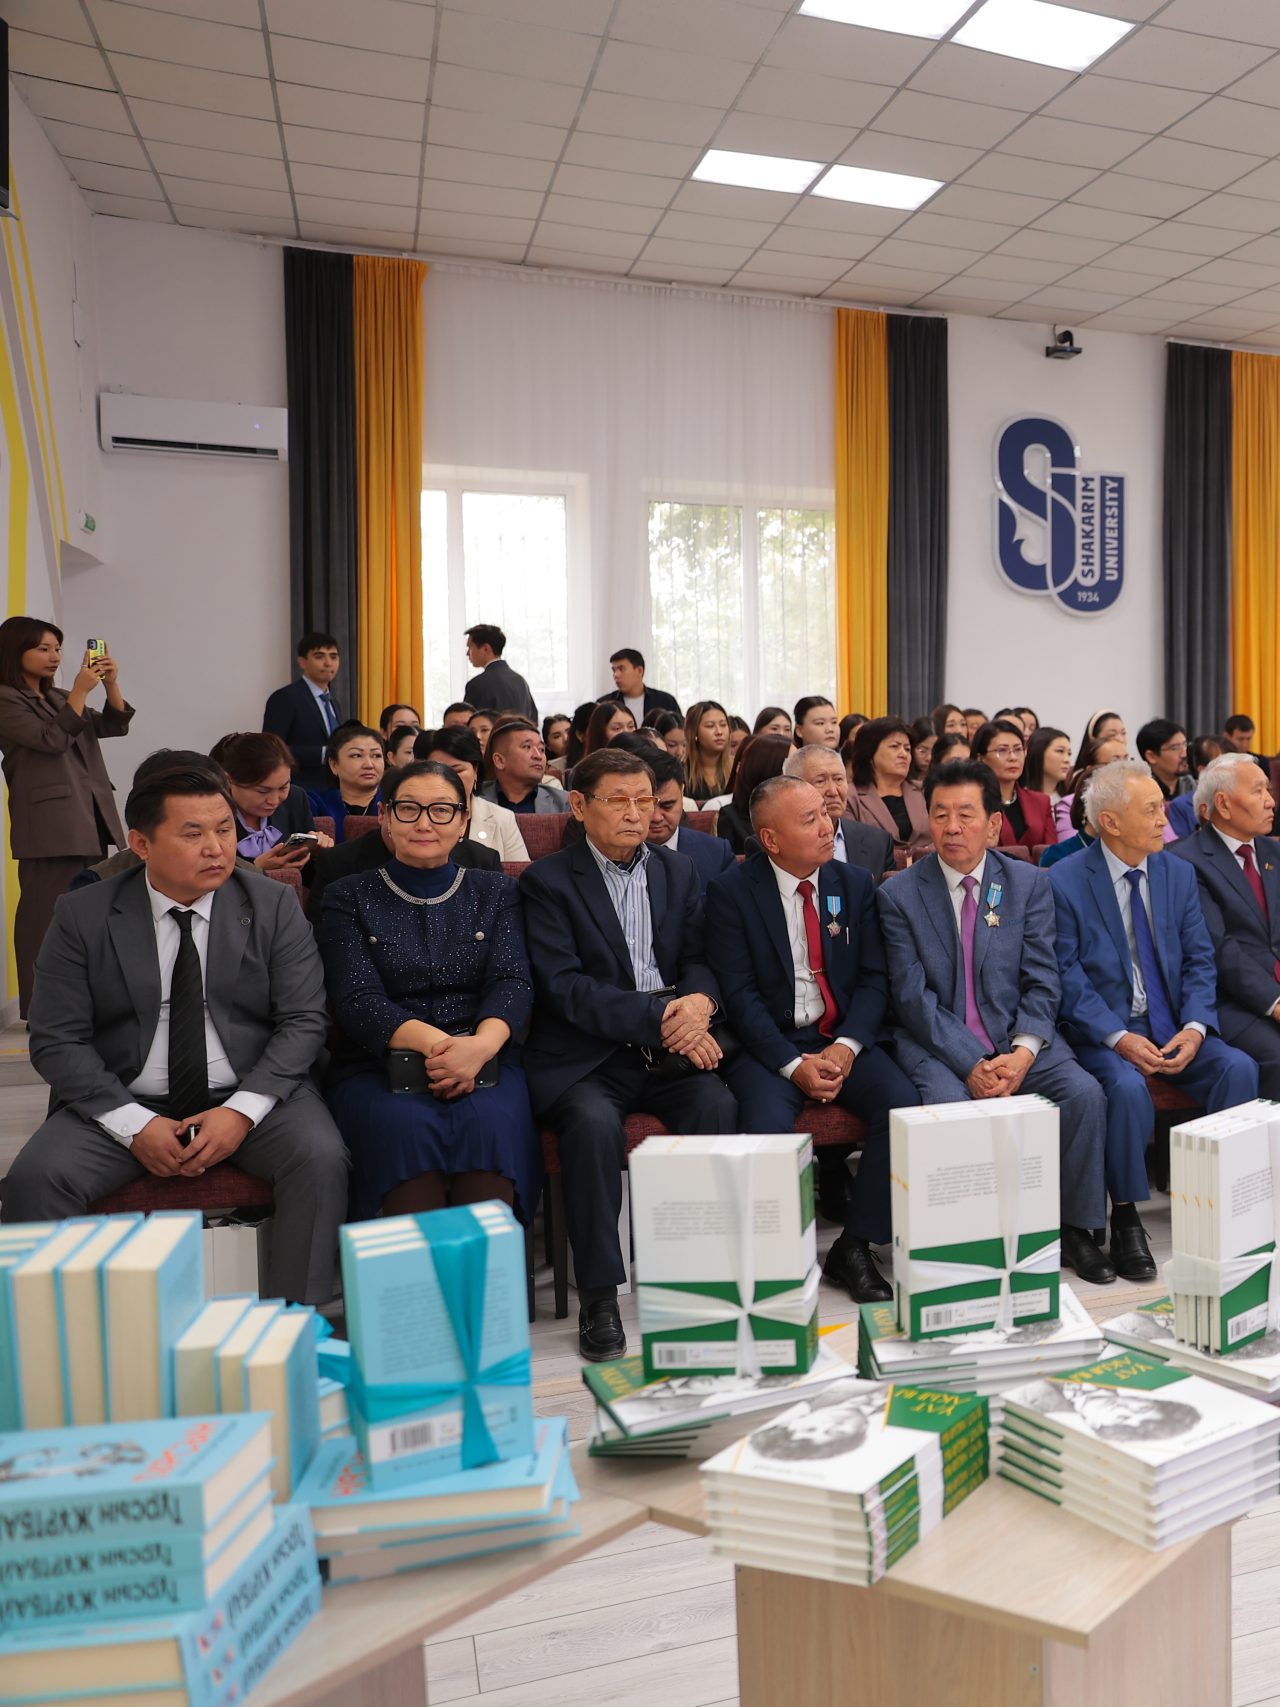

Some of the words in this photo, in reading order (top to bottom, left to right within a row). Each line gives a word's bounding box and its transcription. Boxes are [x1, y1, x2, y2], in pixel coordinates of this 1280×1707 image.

[1081, 476, 1095, 579] SHAKARIM
[1105, 478, 1119, 581] UNIVERSITY
[1077, 591, 1100, 603] 1934
[0, 1505, 94, 1541] ЖҰРТБА
